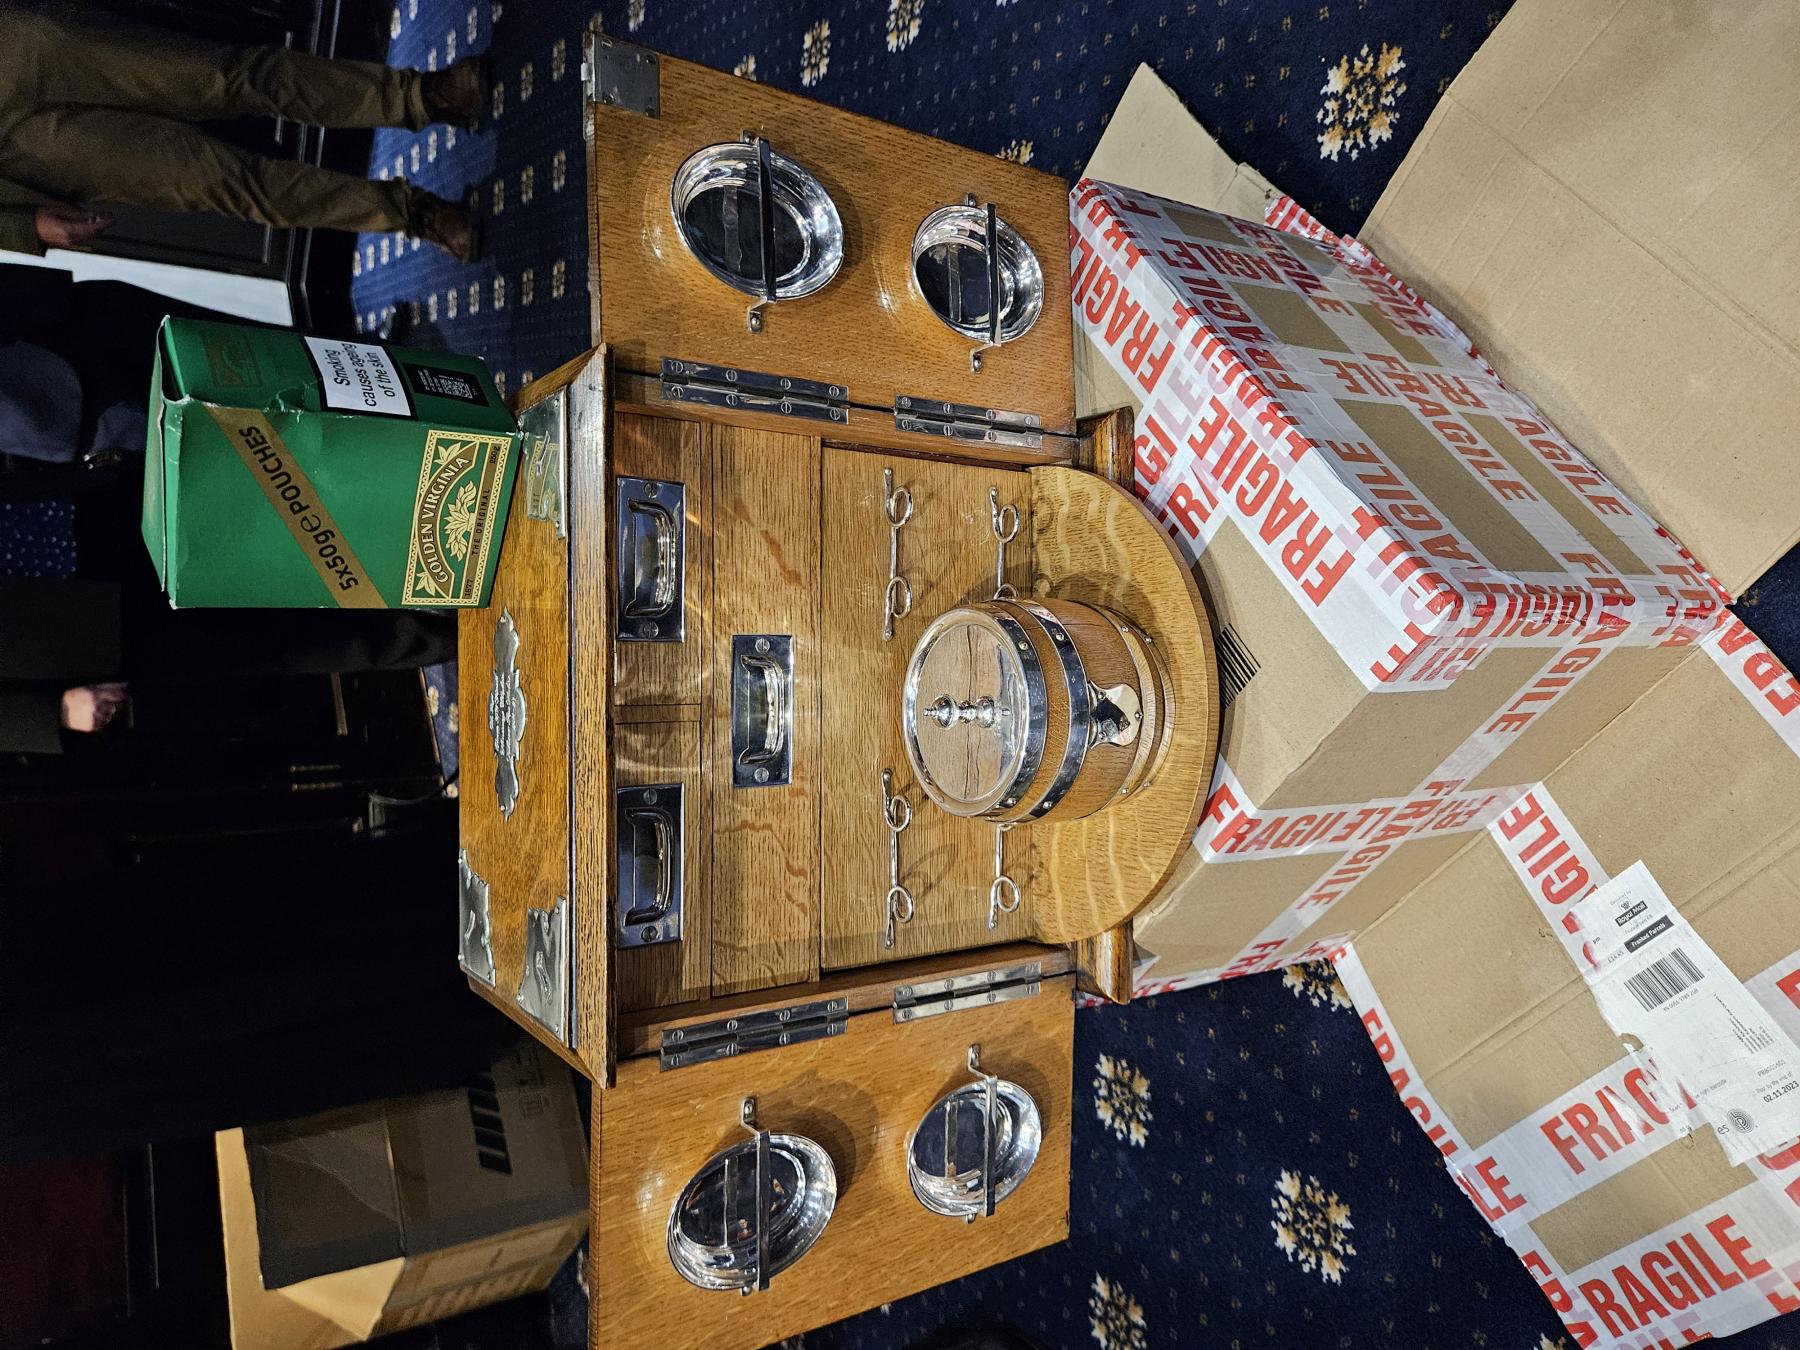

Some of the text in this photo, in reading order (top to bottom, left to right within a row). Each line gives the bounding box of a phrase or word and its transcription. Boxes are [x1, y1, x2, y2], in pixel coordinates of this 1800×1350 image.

[324, 350, 350, 385] Smoking
[342, 343, 377, 406] causes ageing
[365, 352, 395, 397] of the skin
[239, 427, 310, 515] POUCHES
[489, 446, 500, 464] 250g
[421, 457, 470, 583] GOLDEN VIRGINIA
[471, 490, 490, 556] THE ORIGINAL
[1186, 397, 1356, 607] FRAGILE
[463, 579, 474, 597] 1877
[1616, 911, 1634, 926] Royal
[1631, 903, 1645, 915] Mail
[1631, 933, 1650, 948] Franked
[1648, 923, 1665, 937] Parcels
[1762, 1078, 1799, 1106] 02.11.2023
[1578, 1214, 1772, 1338] RAGILE
